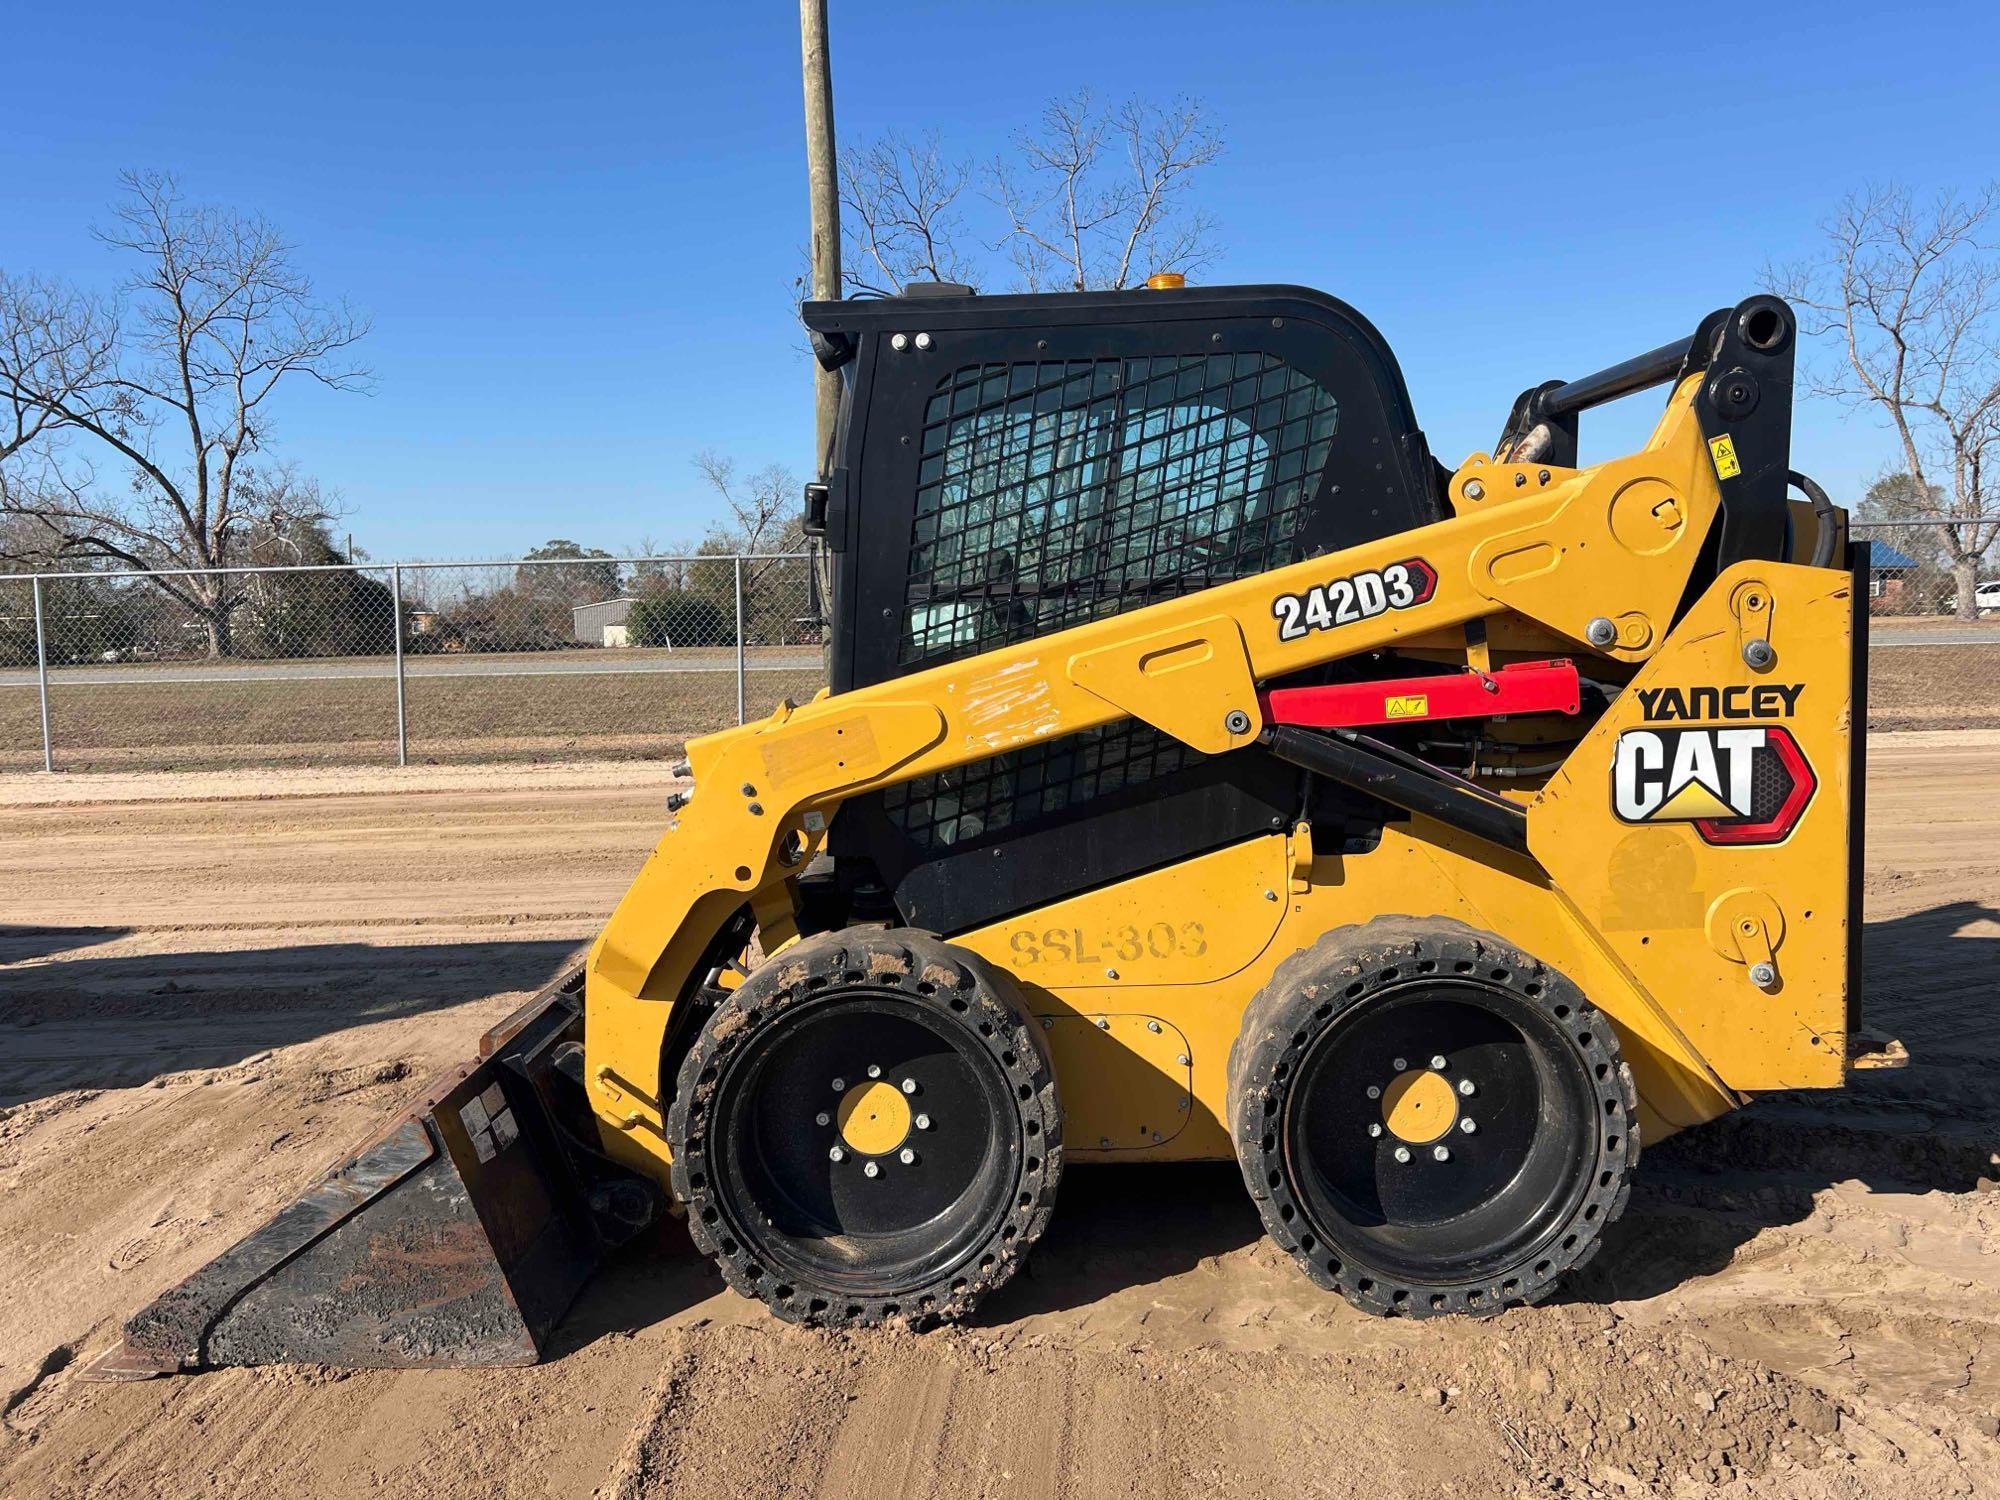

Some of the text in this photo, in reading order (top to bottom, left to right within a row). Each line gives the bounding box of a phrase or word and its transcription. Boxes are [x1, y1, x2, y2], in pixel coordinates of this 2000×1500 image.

[1274, 564, 1415, 640] 242D3
[1634, 683, 1807, 721] YANCEY
[1615, 728, 1766, 820] CAT
[1010, 921, 1208, 968] SSL-303
